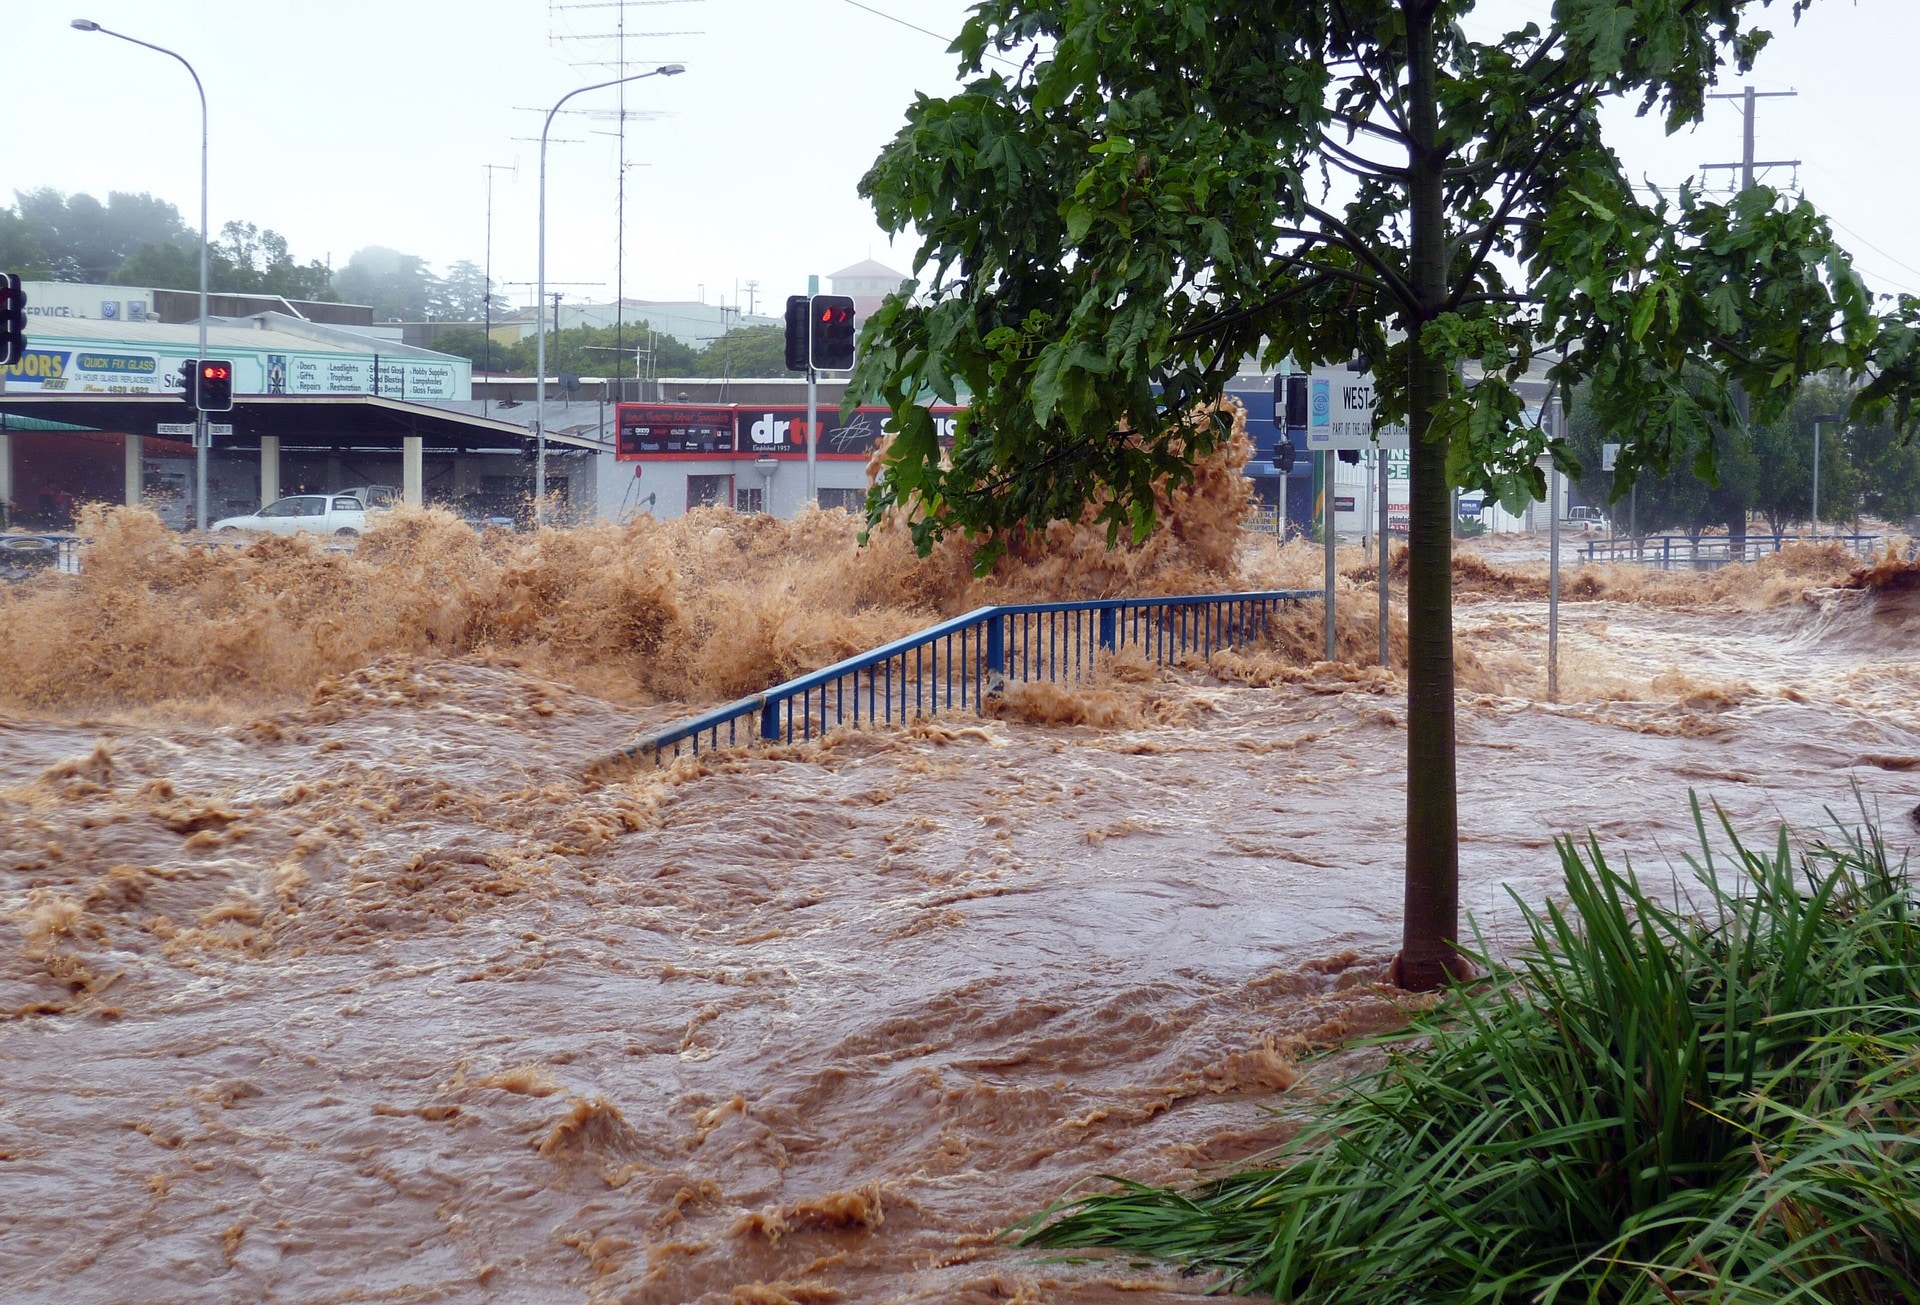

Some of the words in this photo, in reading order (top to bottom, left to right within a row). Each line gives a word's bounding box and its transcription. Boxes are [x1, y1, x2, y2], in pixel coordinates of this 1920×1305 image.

[23, 306, 69, 318] ERVICE
[83, 356, 108, 368] QUICK
[112, 358, 125, 369] FIX
[128, 360, 154, 371] GLASS
[300, 361, 317, 371] Doors
[330, 363, 359, 375] Leadlights
[300, 371, 315, 381] Gifts
[330, 373, 353, 383] Trophies
[412, 366, 427, 378] Hobby
[428, 368, 449, 379] Supplies
[44, 379, 64, 389] PLUS
[75, 373, 81, 381] 24
[83, 374, 98, 382] HOUR
[100, 375, 118, 383] GLASS
[119, 376, 157, 385] REPLACEMENT
[384, 375, 404, 384] Blastin
[412, 376, 442, 387] Lampshades
[300, 381, 321, 392] Repairs
[330, 382, 361, 392] Restoration
[384, 384, 404, 393] Bendin
[412, 386, 426, 394] Glass
[427, 387, 443, 395] Fusion
[1343, 386, 1370, 409] WEST
[1332, 422, 1344, 436] PART
[1345, 422, 1351, 436] OF
[1353, 422, 1361, 436] THE
